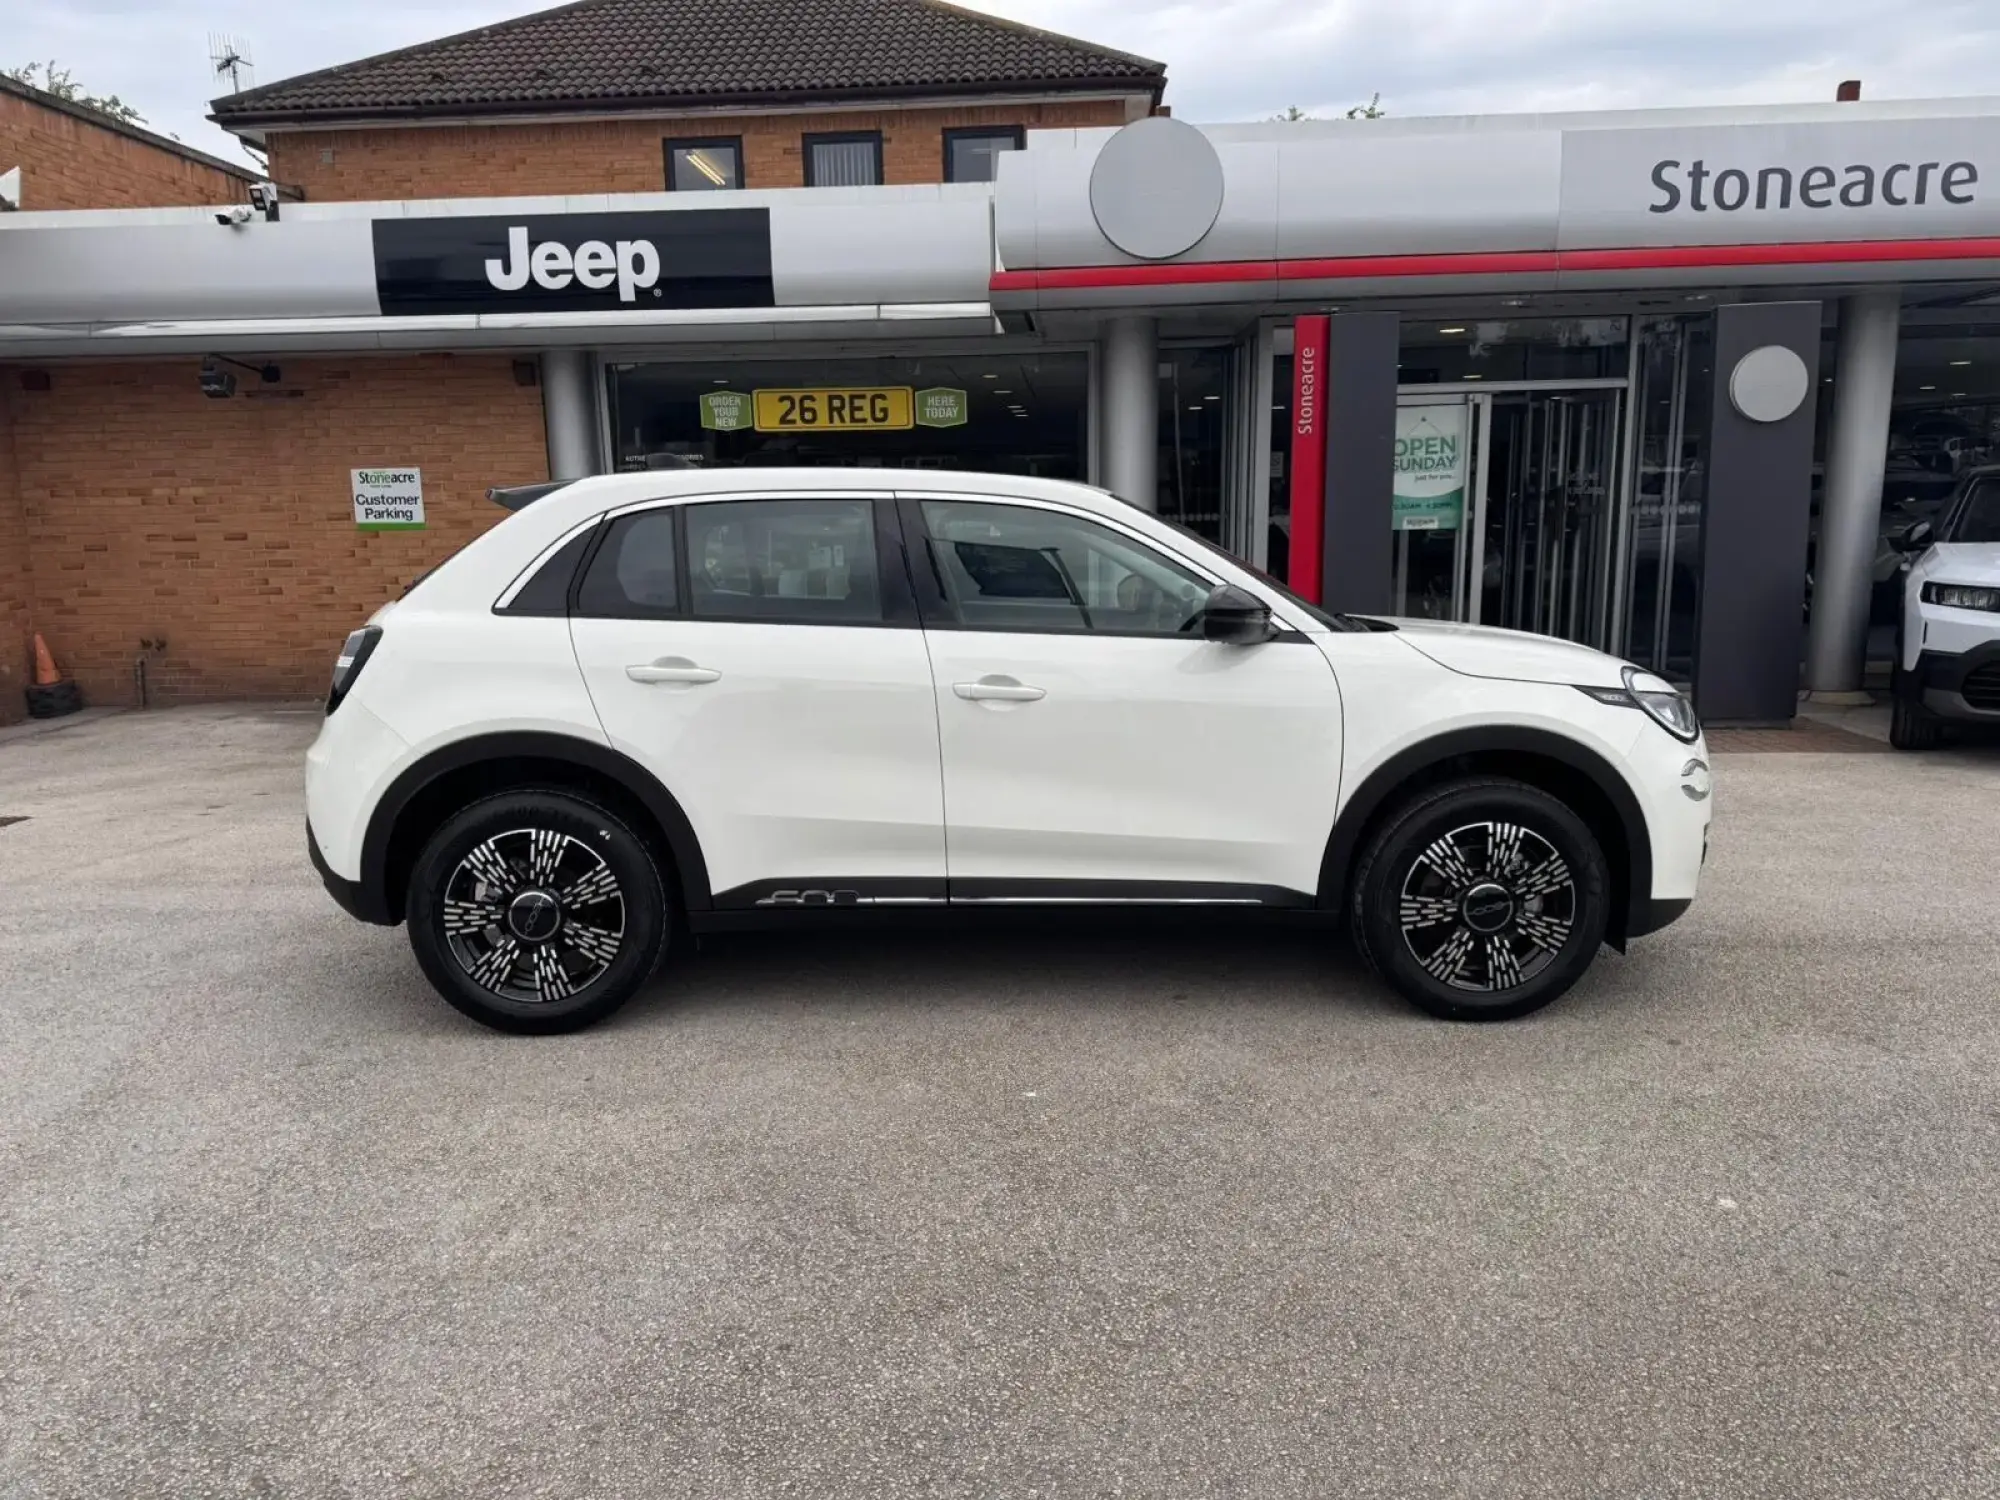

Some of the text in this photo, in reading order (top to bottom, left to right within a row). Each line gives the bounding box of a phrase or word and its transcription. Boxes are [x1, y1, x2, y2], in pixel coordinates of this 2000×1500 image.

[1649, 160, 1979, 213] Stoneacre
[485, 226, 661, 302] Jeep
[1298, 347, 1315, 435] Stoneacre
[928, 396, 956, 406] HERE
[778, 393, 889, 425] 26 REG
[924, 407, 959, 419] TODAY
[715, 417, 737, 427] NEW
[1395, 435, 1456, 456] OPEN
[1393, 455, 1456, 471] SUNDAY
[359, 471, 415, 484] Stoneacre
[356, 494, 420, 505] Customer
[365, 508, 413, 521] Parking
